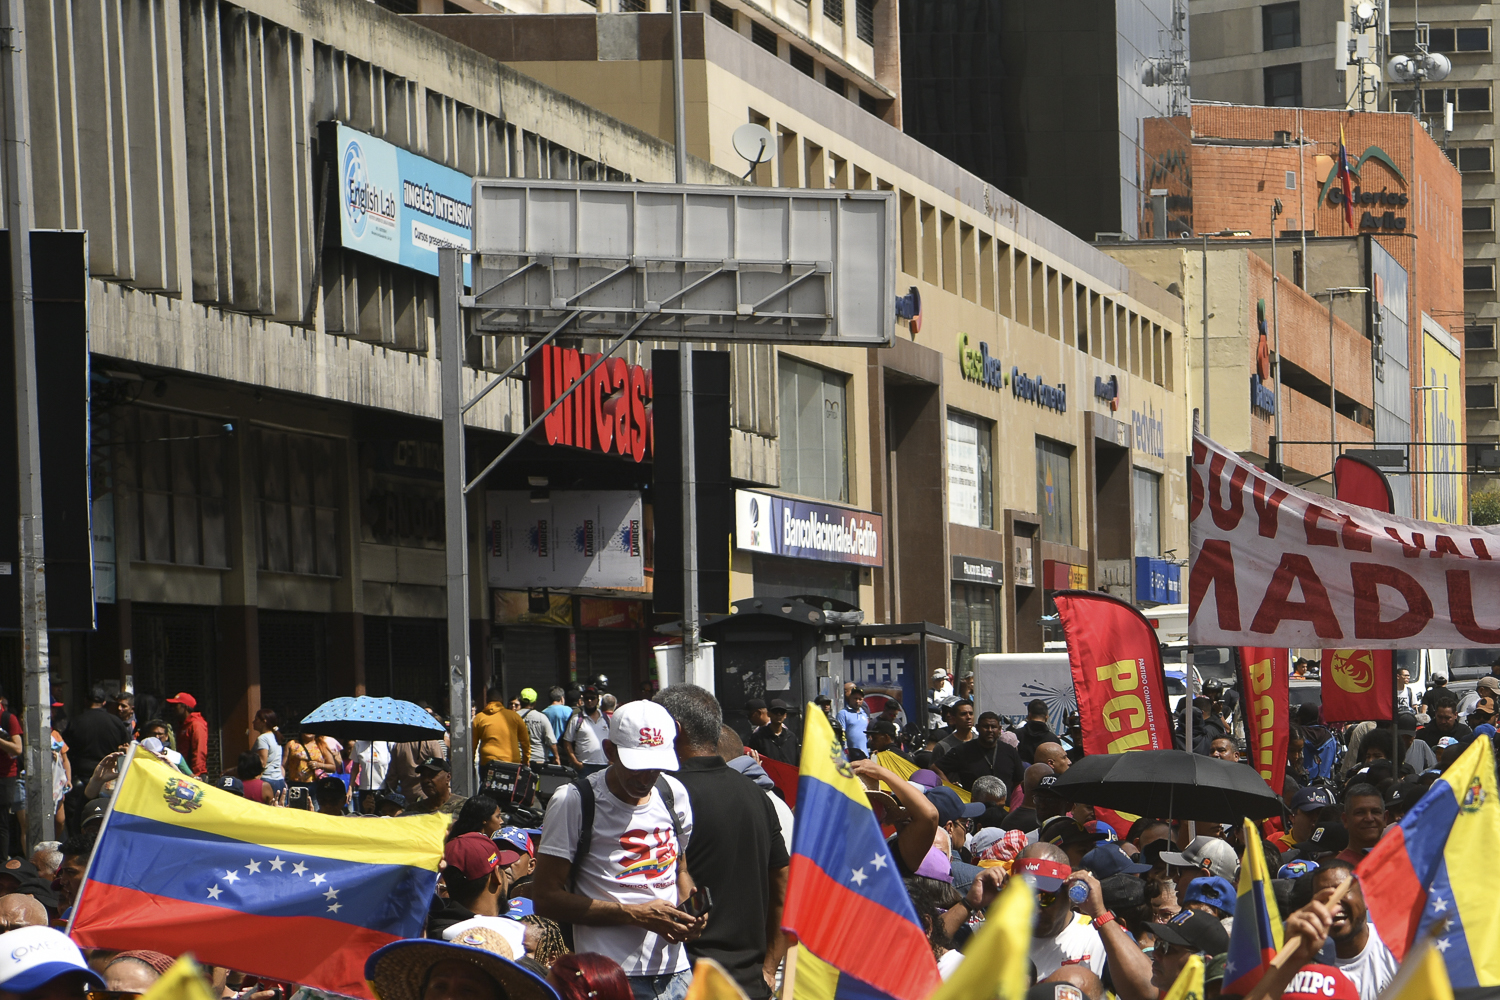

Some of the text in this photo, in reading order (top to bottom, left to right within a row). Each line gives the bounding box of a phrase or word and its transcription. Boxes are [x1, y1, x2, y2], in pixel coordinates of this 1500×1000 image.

[350, 179, 395, 218] English Lab
[1329, 186, 1408, 205] Glerías
[542, 343, 653, 463] unicas
[632, 520, 640, 557] LAMIDECO
[1138, 658, 1148, 684] PARTIDO
[1143, 685, 1155, 722] COMUNISTA
[1283, 971, 1335, 997] NIPC
